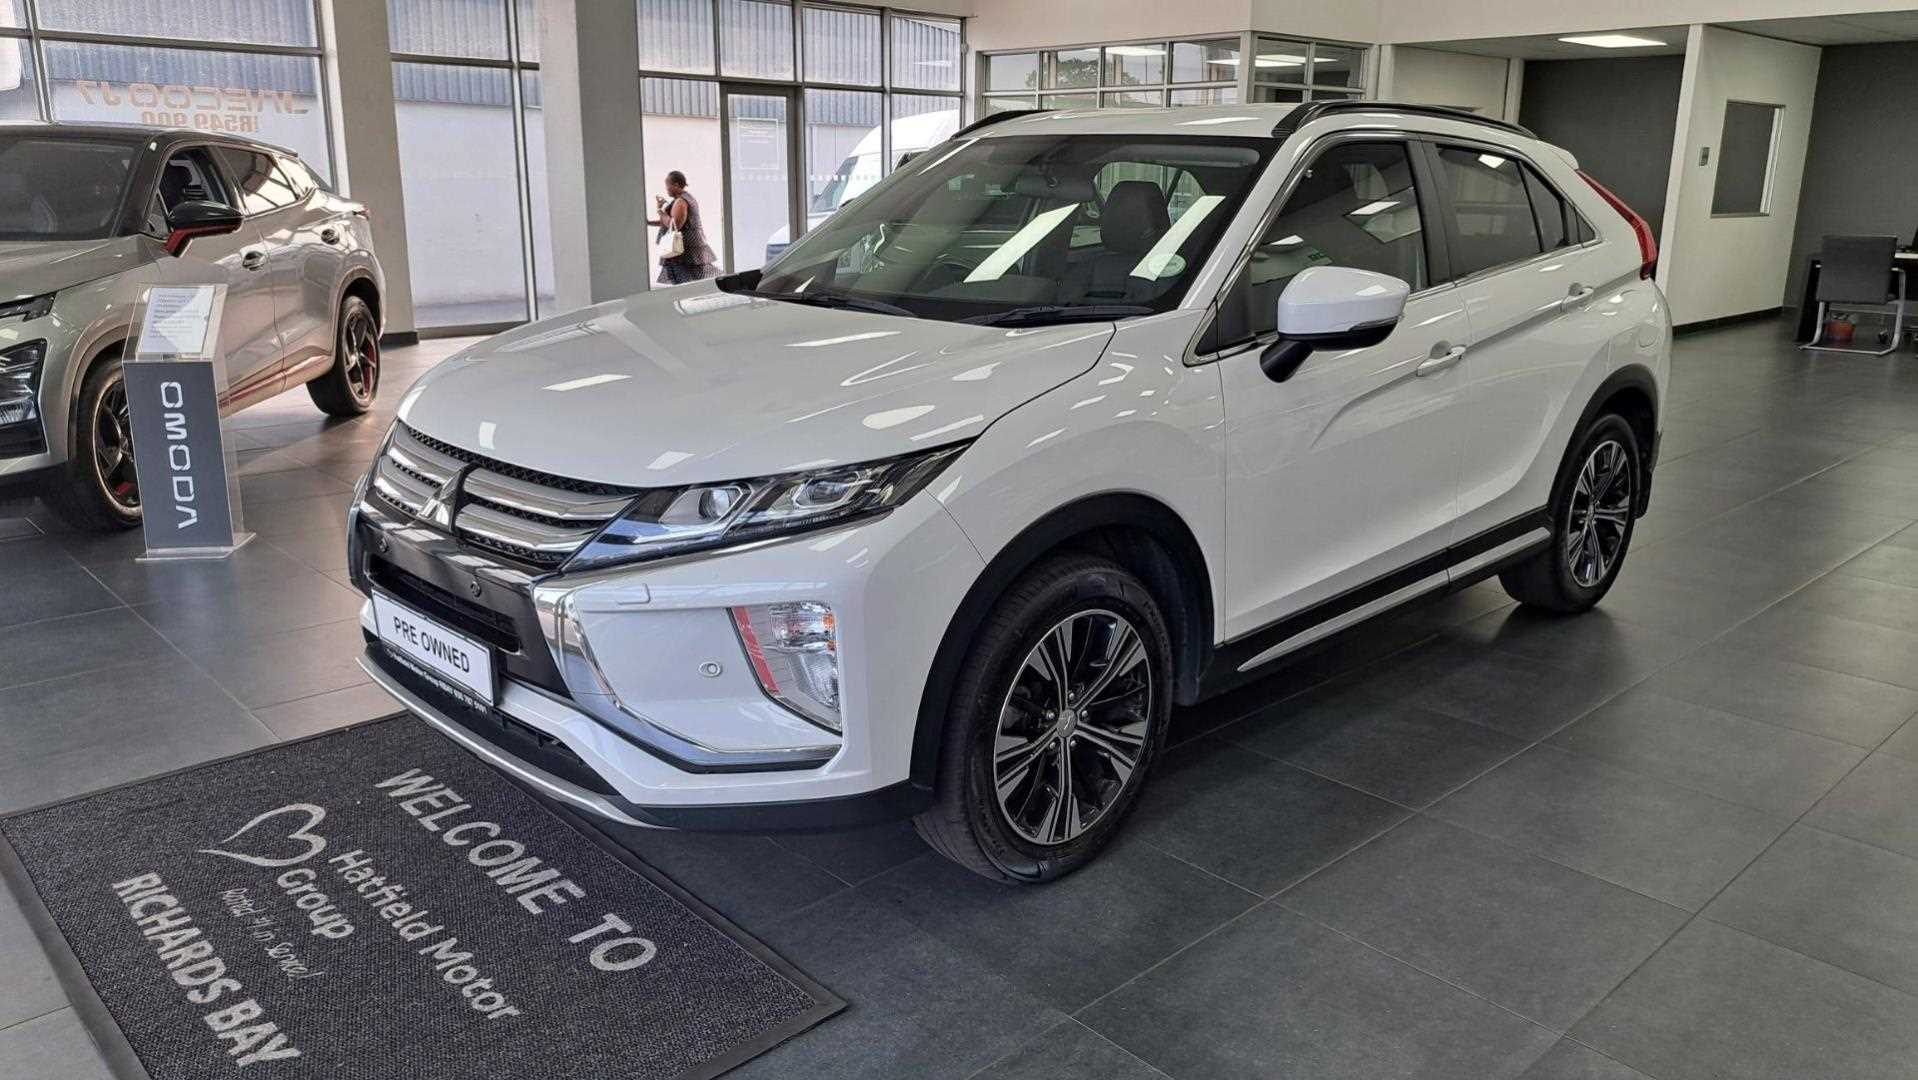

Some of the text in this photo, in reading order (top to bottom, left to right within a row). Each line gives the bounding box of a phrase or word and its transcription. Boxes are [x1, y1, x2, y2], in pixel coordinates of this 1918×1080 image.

[160, 381, 198, 529] OMODA
[393, 615, 470, 673] PRE OWNED
[277, 867, 355, 939] Group
[328, 849, 521, 1020] Hatfield Motor
[374, 767, 658, 972] WELCOME TO
[112, 871, 301, 1067] RICHARDS BAY
